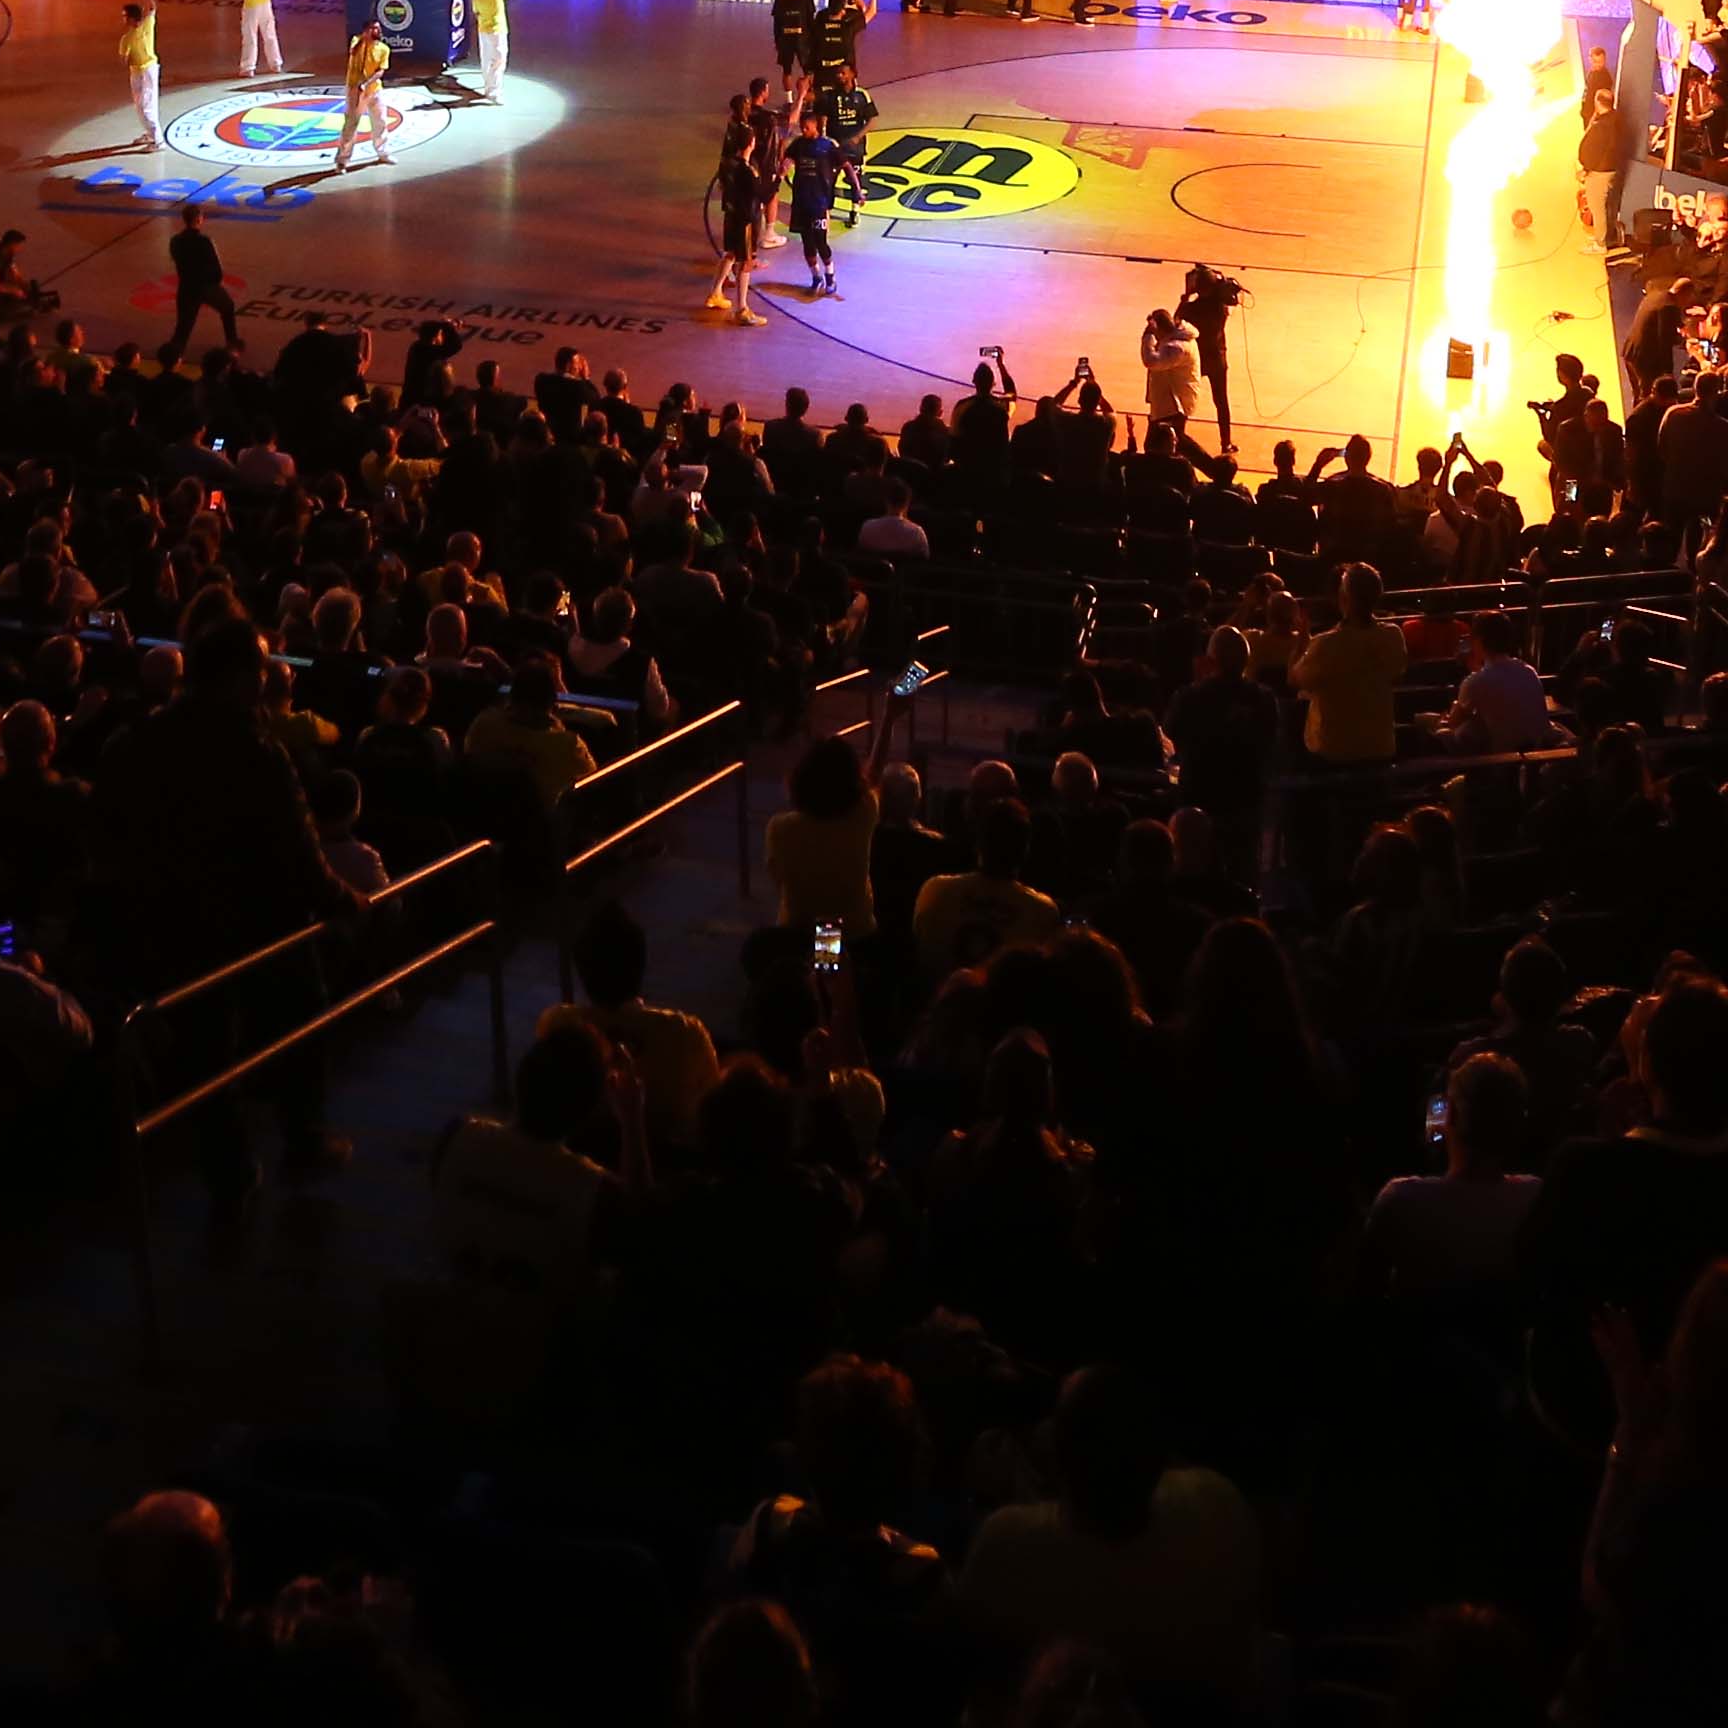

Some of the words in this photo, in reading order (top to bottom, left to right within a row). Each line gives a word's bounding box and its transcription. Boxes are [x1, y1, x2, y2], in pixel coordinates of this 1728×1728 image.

[75, 165, 317, 212] beko
[234, 299, 547, 346] EuroLegue
[269, 283, 458, 315] TURKISH
[461, 301, 671, 336] AIRLINES
